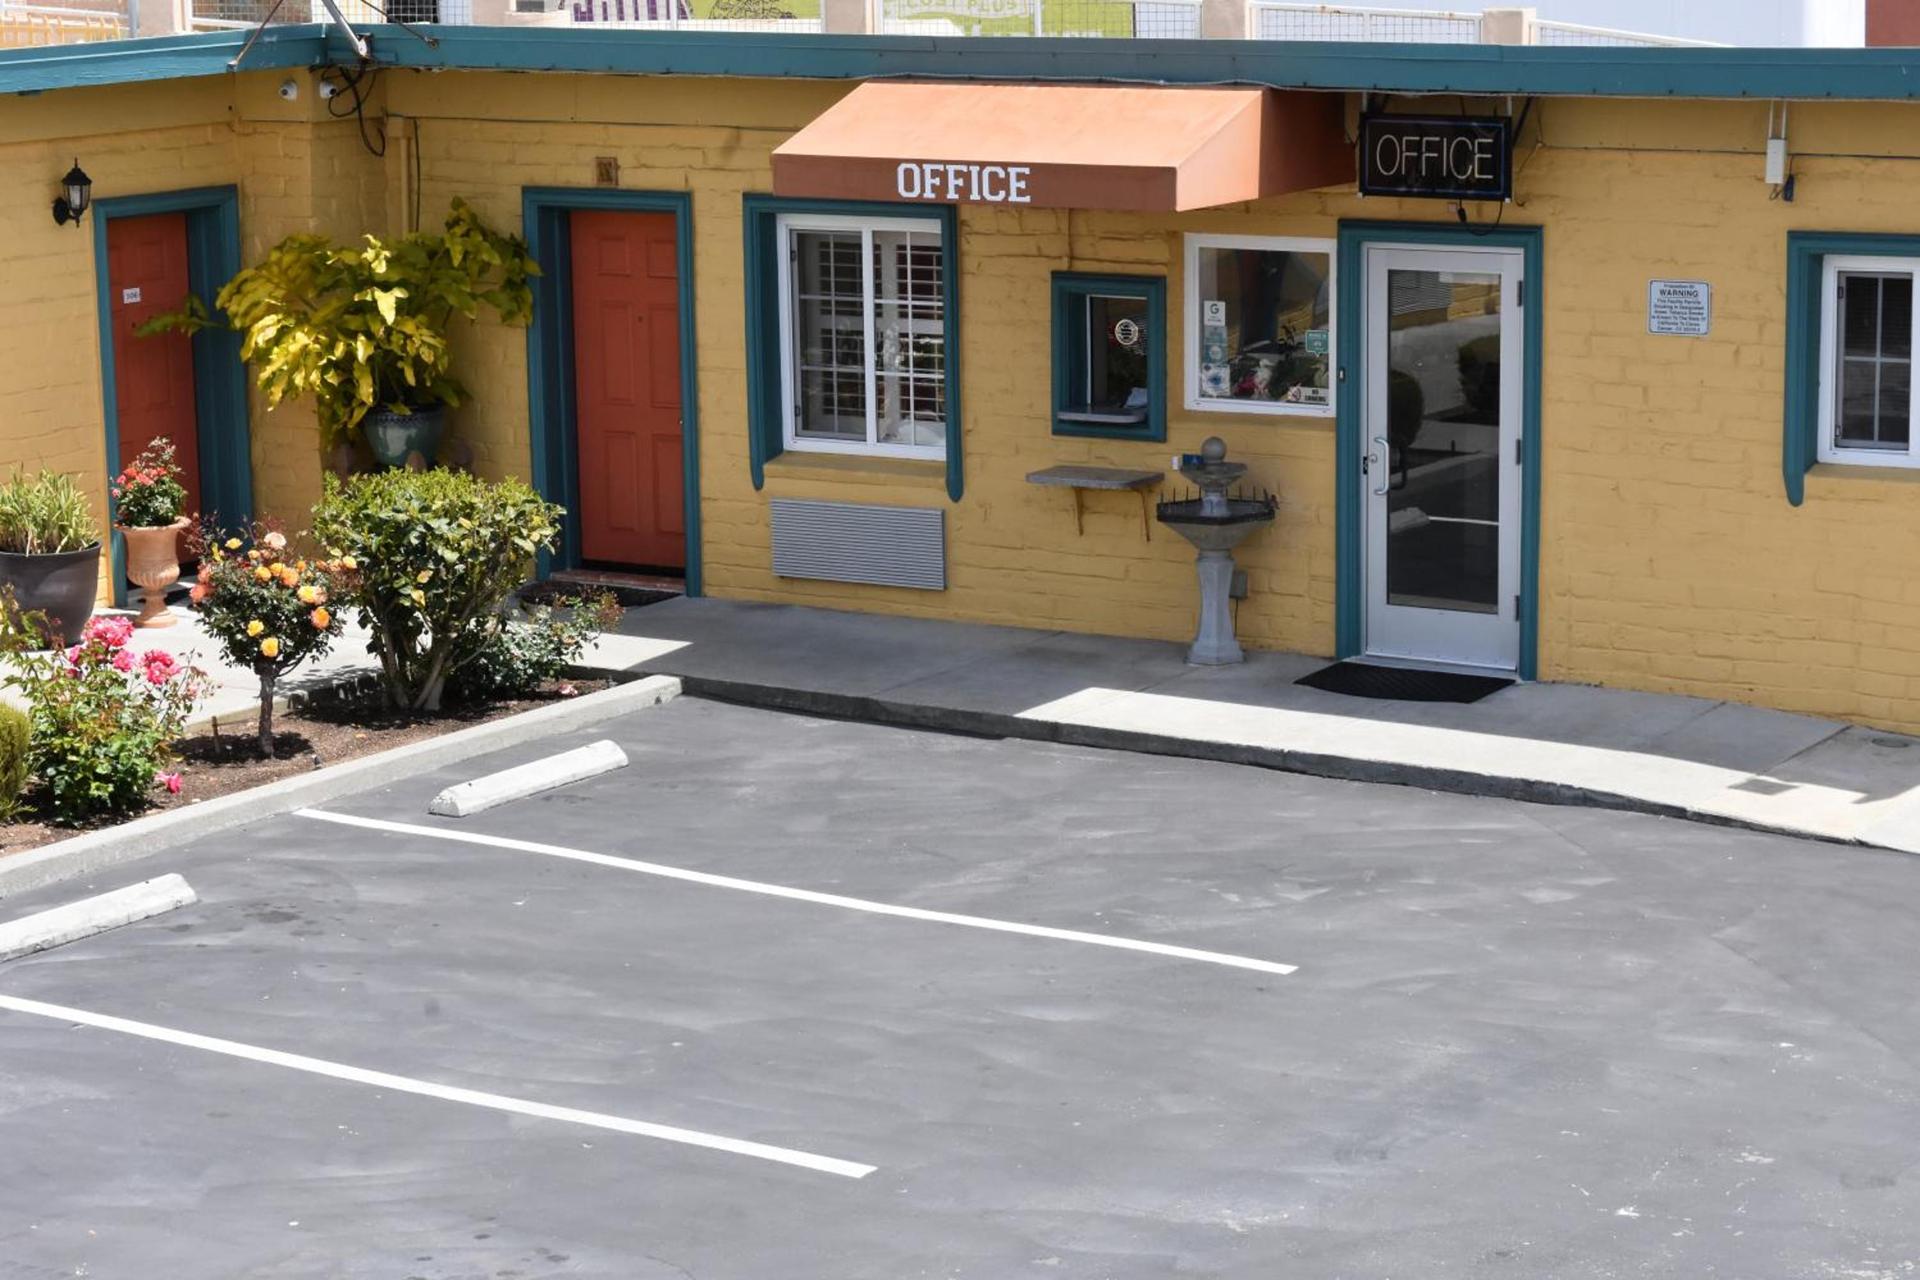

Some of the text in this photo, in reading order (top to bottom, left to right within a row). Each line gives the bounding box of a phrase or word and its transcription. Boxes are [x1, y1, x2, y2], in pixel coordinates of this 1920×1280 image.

[1376, 134, 1494, 180] OFFICE
[897, 162, 1031, 203] OFFICE
[1659, 289, 1699, 297] WARNING
[1210, 303, 1219, 314] G
